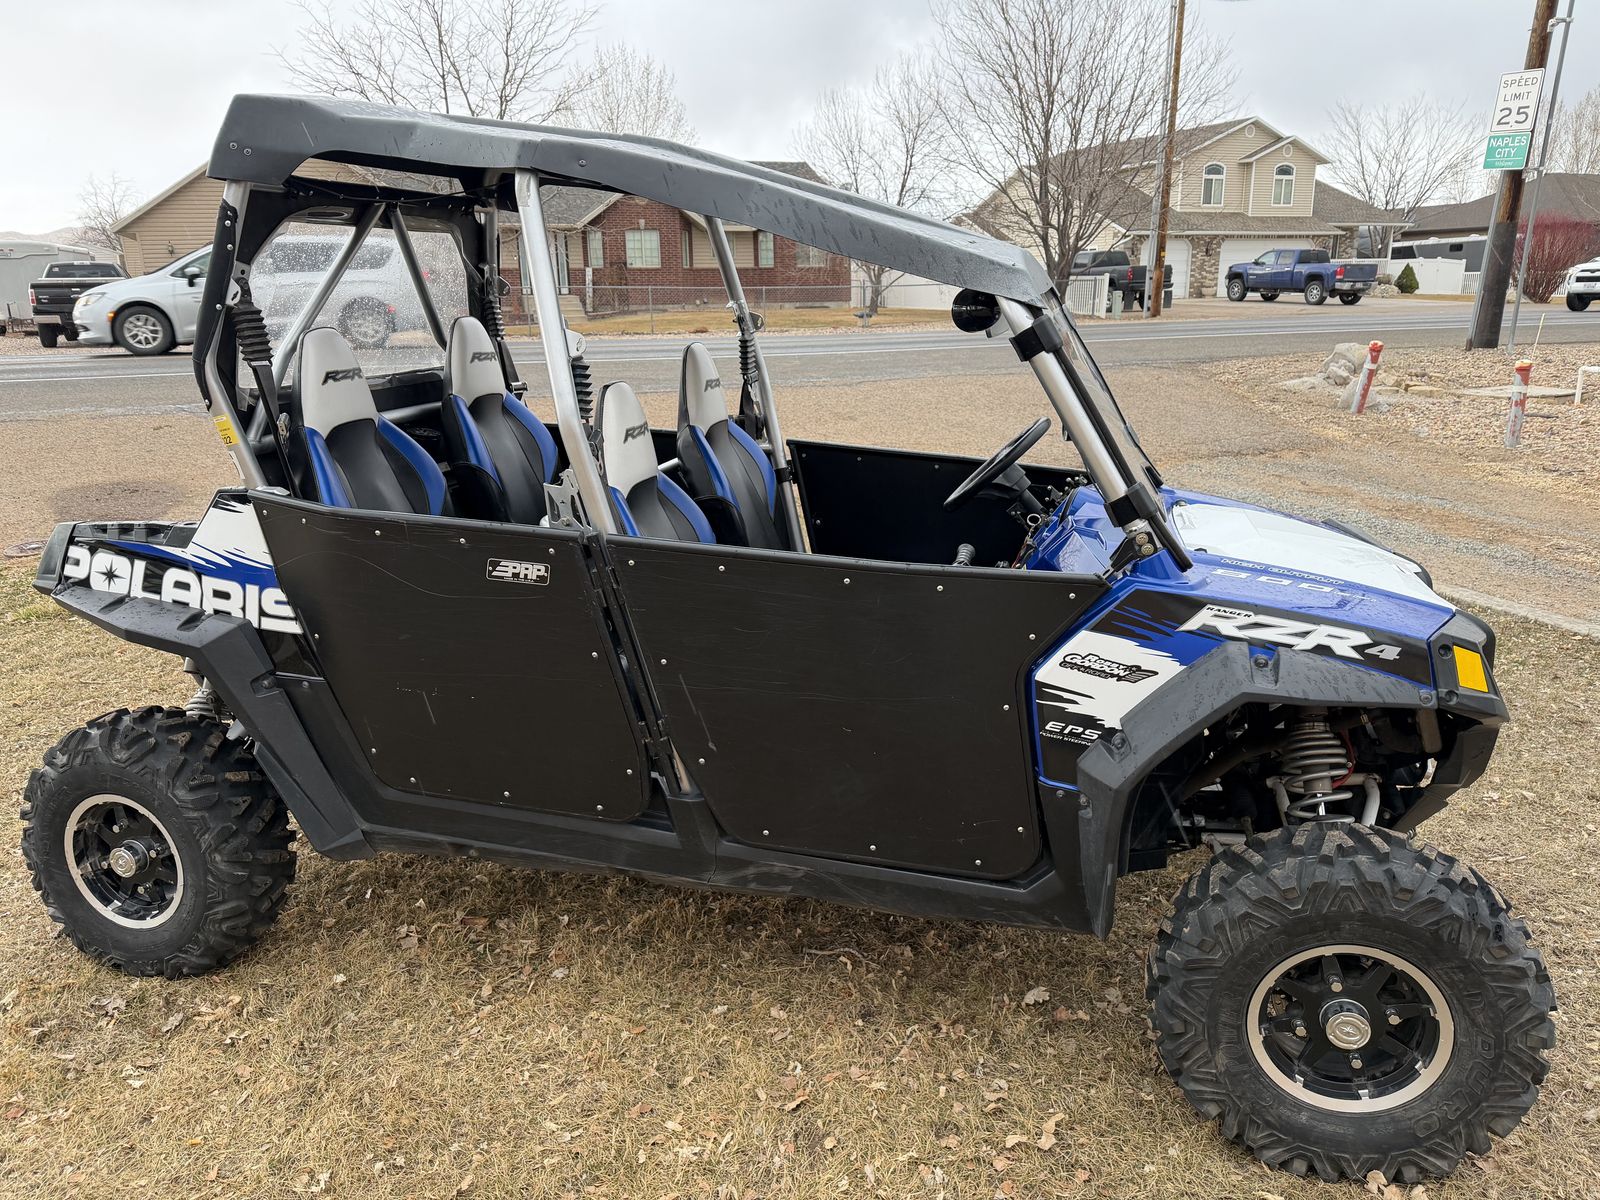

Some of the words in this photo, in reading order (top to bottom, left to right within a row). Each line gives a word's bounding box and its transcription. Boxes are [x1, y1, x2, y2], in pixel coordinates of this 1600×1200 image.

[1503, 77, 1538, 88] SPEED
[1503, 91, 1532, 101] LIMIT
[1496, 105, 1530, 126] 25
[1489, 136, 1527, 147] NAPLES
[1495, 148, 1517, 158] CITY
[470, 352, 497, 364] RZR
[321, 367, 363, 385] RZR
[63, 545, 303, 634] POLARIS
[1206, 606, 1252, 618] RANGER
[1176, 604, 1373, 660] RZR
[1364, 645, 1402, 660] 4
[1045, 721, 1102, 740] EPS
[1064, 736, 1092, 746] STEERIN
[1413, 1030, 1496, 1138] DURO
